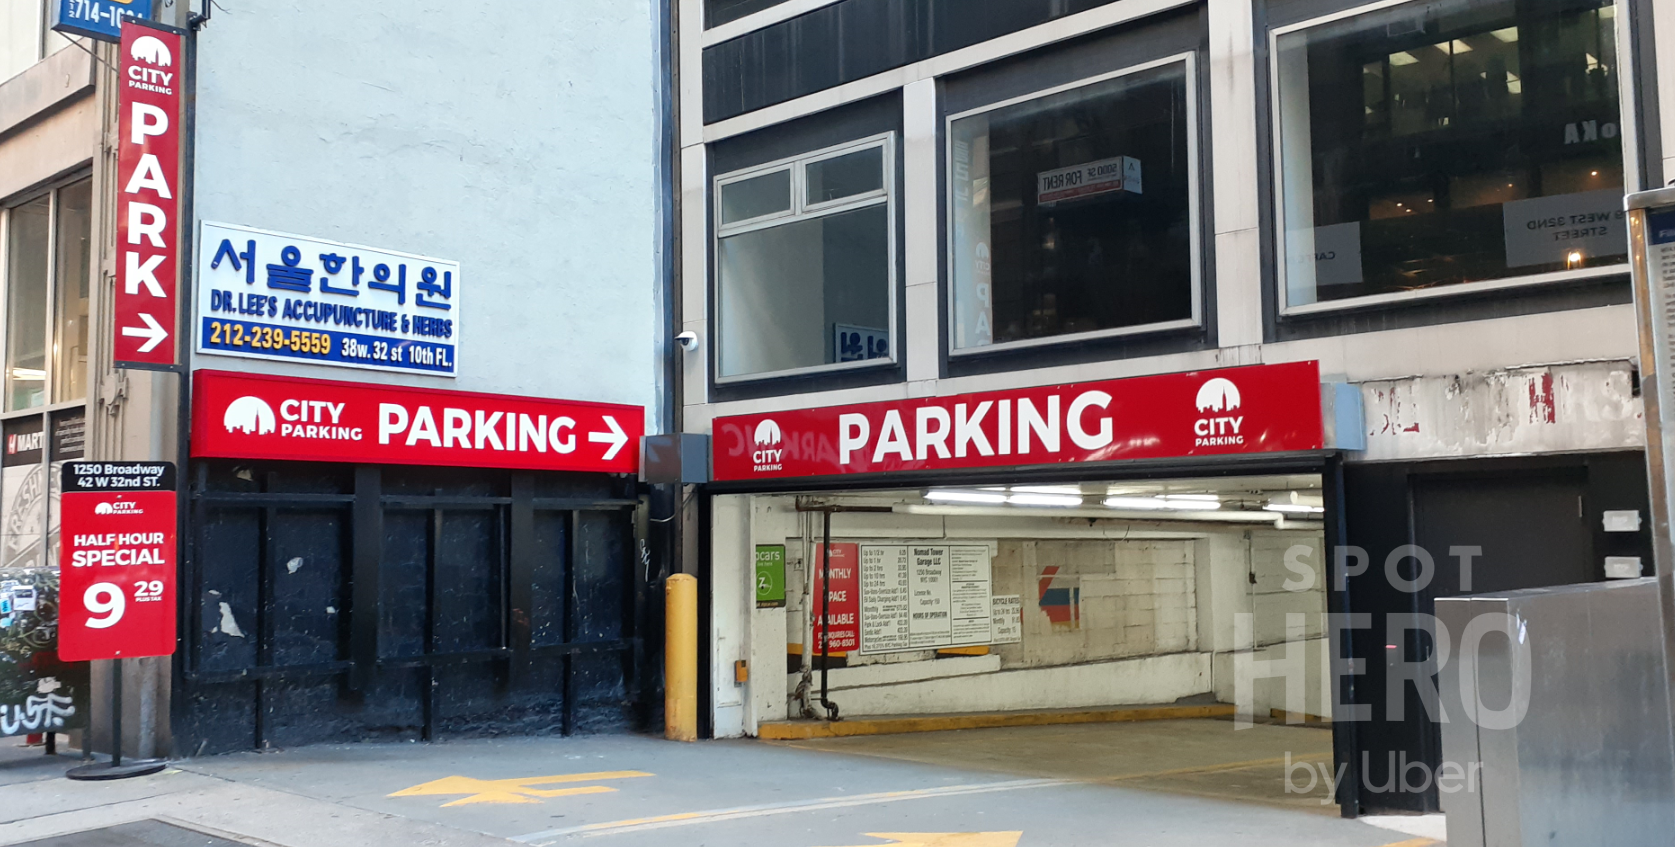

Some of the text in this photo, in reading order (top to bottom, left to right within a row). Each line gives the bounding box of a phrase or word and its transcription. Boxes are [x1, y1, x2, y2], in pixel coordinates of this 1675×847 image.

[75, 0, 143, 29] 714-10
[127, 66, 173, 86] CITY
[128, 80, 173, 95] PARKING
[124, 101, 173, 298] PARK
[211, 239, 452, 310] 서울한의원
[282, 298, 397, 332] ACCUPUNCTURE
[401, 314, 409, 333] &
[412, 315, 453, 339] HERBS
[210, 321, 331, 355] 212-239-5559
[373, 341, 388, 360] 32
[391, 345, 403, 362] st
[409, 345, 434, 365] 10th
[435, 349, 452, 367] FL.
[280, 399, 576, 455] CITY PARKING
[281, 423, 362, 441] PARKING
[839, 390, 1113, 464] PARKING
[1194, 416, 1244, 436] CITY
[1195, 435, 1244, 447] PARKING
[752, 449, 783, 465] CITY
[73, 464, 165, 477] 1250 Broadway
[754, 464, 783, 472] PARKING
[77, 477, 161, 487] 42 W 32nd ST.
[73, 532, 164, 547] HALF HOUR
[71, 548, 165, 567] SPECIAL
[818, 568, 852, 580] MNTHLY
[83, 580, 164, 629] 9 29
[817, 613, 855, 626] AAILABLE
